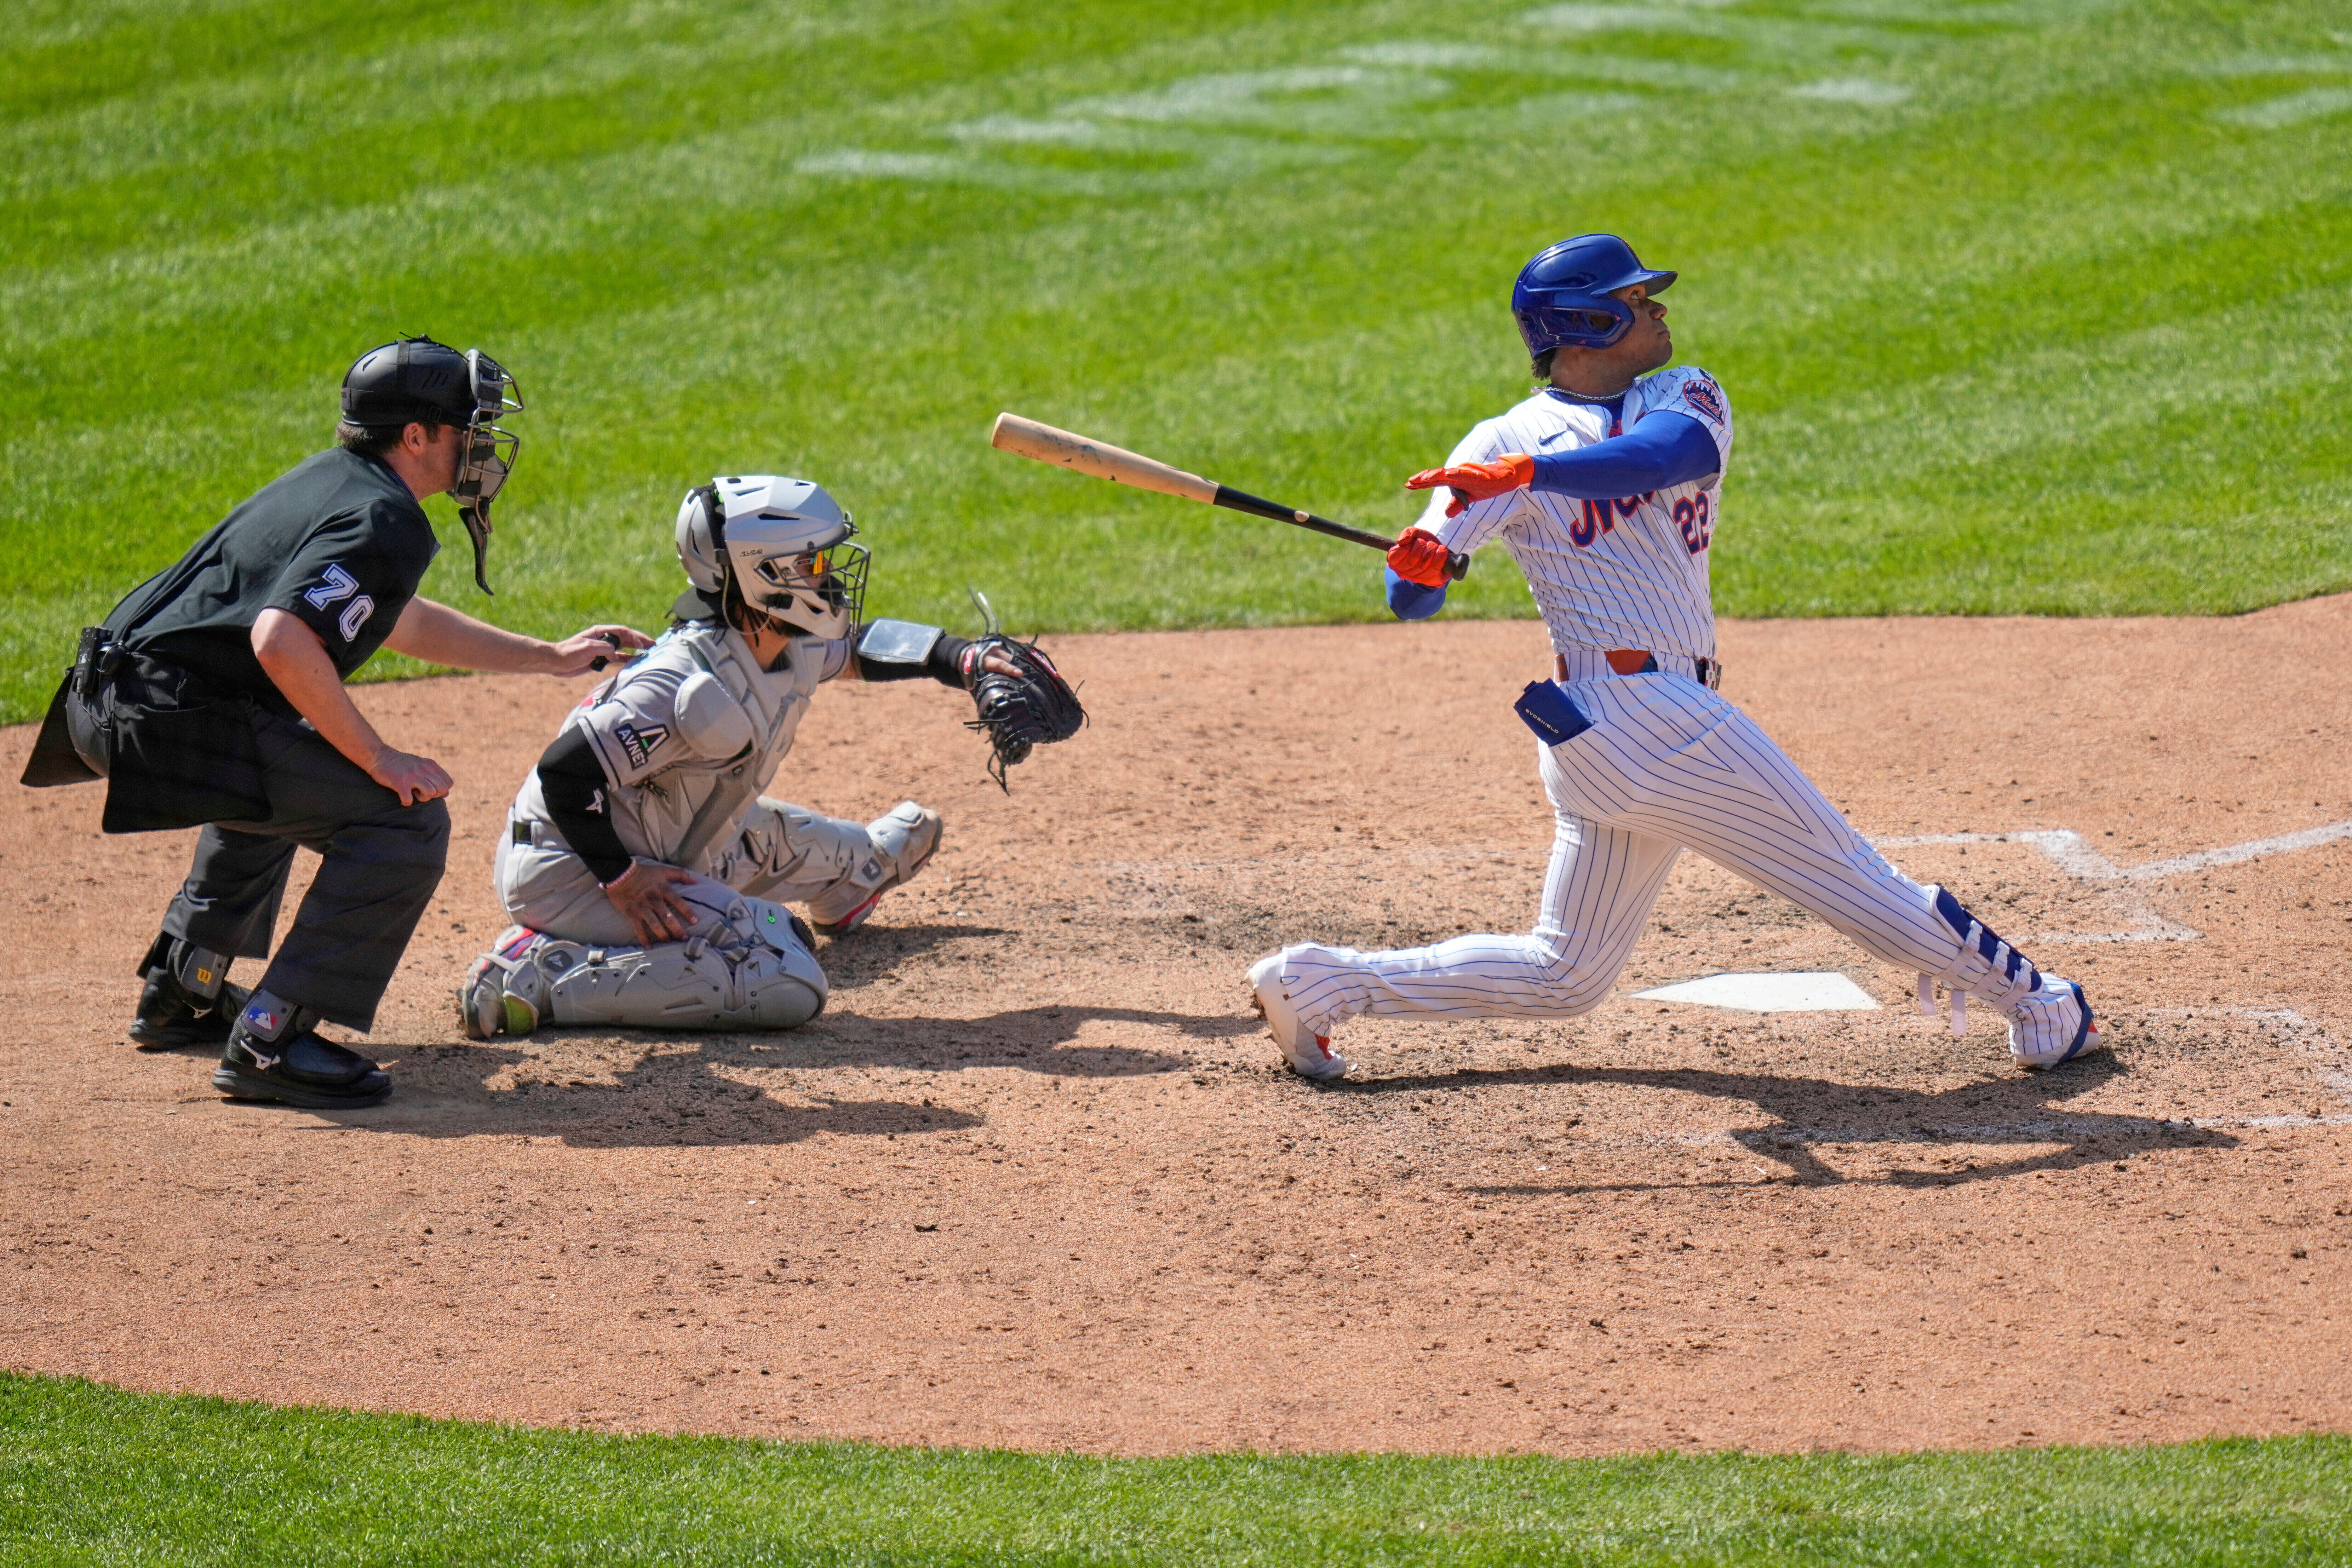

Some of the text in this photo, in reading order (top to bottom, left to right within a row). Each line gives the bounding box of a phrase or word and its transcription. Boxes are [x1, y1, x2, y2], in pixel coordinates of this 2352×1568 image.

[1690, 392, 1720, 417] Mets
[1673, 491, 1709, 556] 22
[304, 563, 374, 642] 70
[618, 729, 646, 767] AVNET
